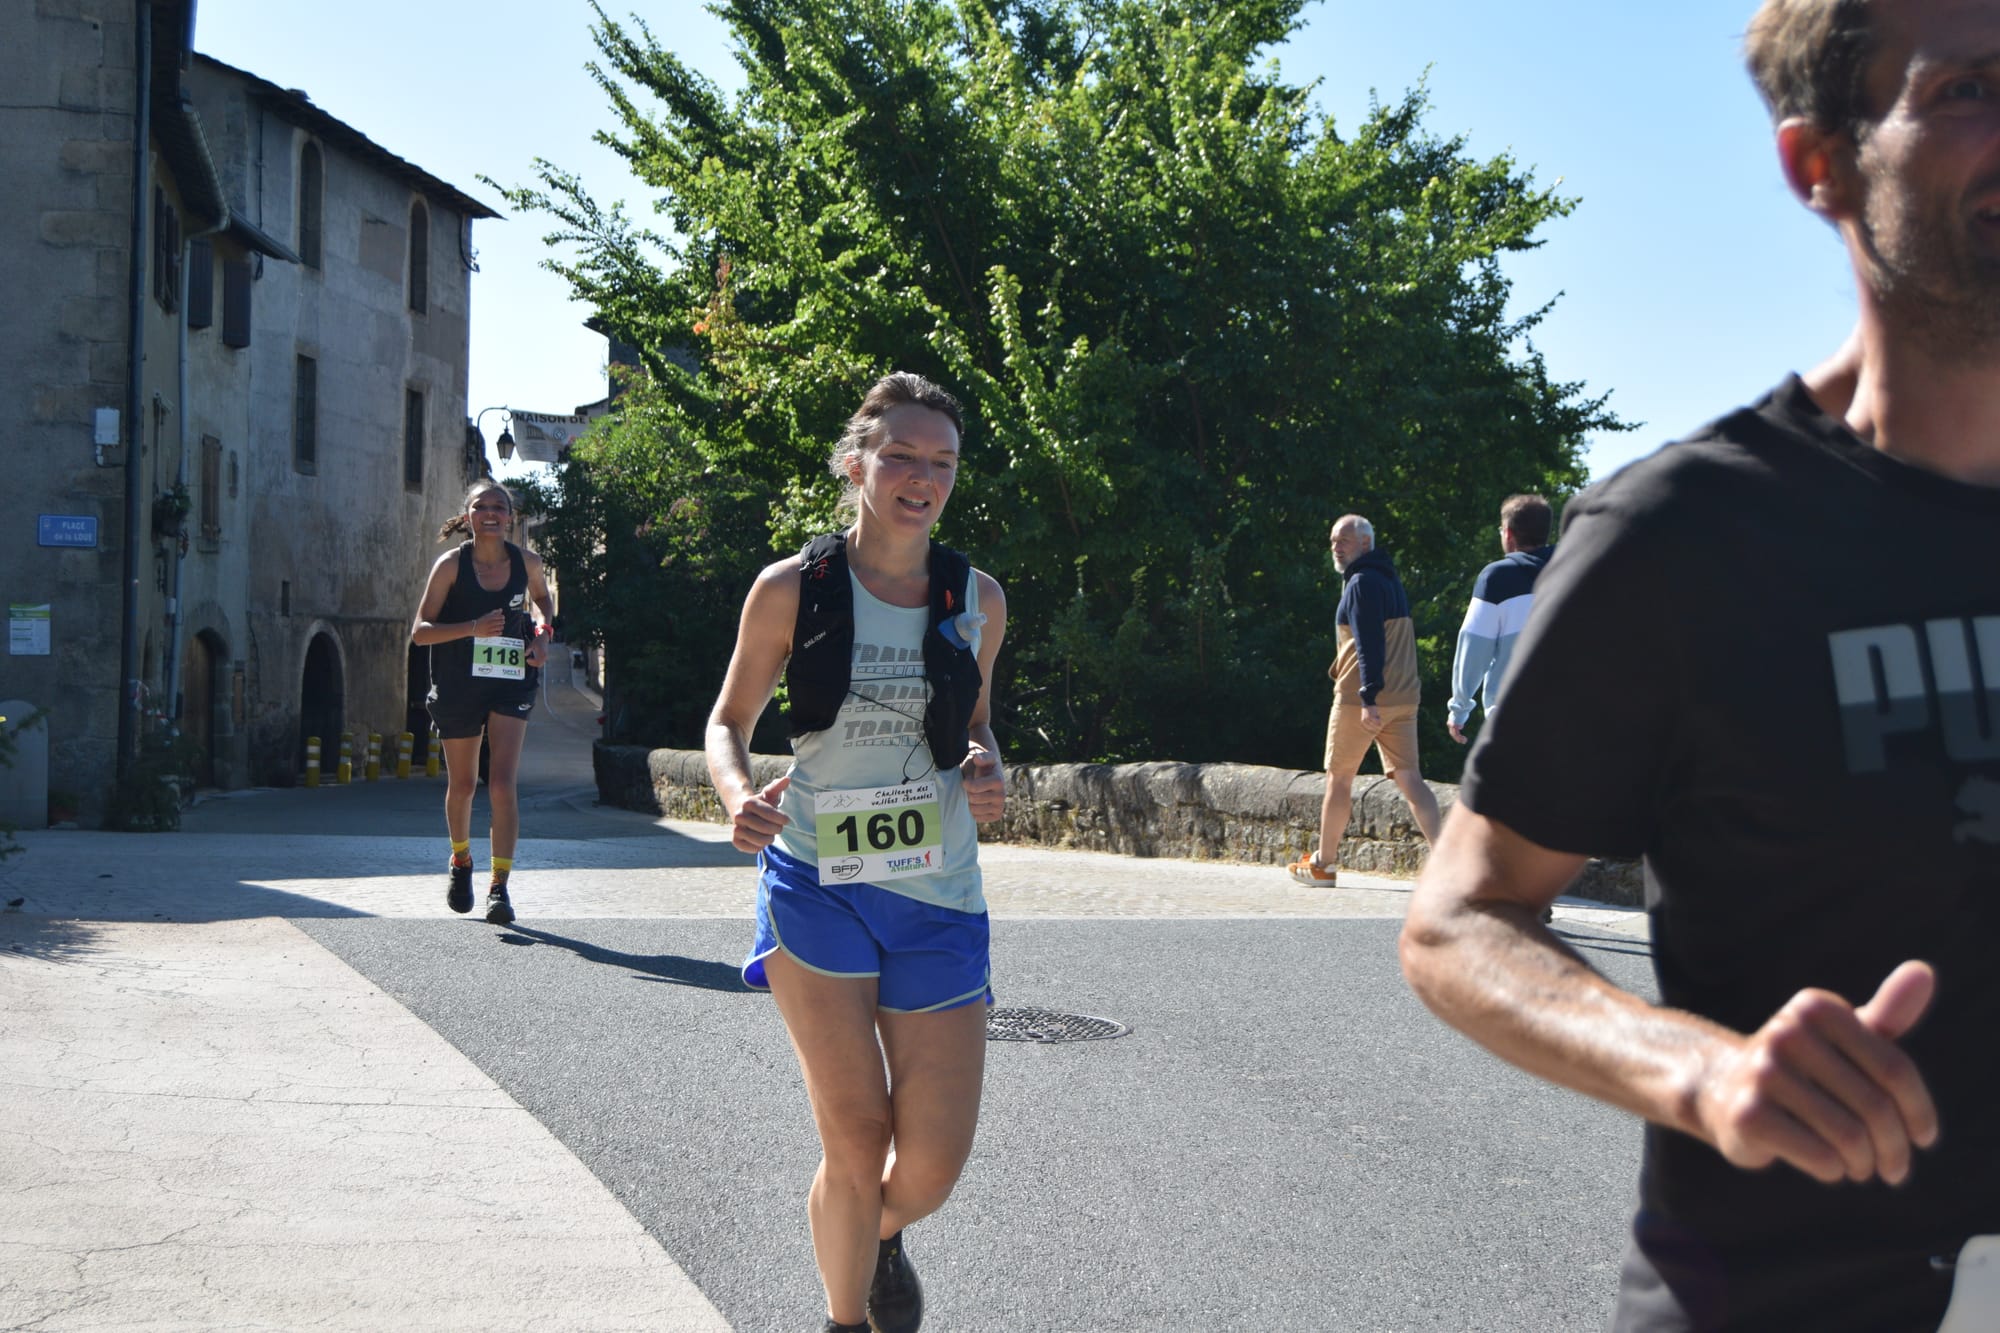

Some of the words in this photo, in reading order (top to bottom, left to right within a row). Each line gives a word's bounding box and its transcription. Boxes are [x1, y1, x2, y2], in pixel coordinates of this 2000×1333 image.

[515, 413, 566, 424] MAISON
[570, 416, 586, 424] DE
[62, 521, 86, 530] PLACE
[482, 647, 519, 666] 118
[875, 788, 912, 798] Challenge
[917, 785, 929, 793] des
[836, 809, 925, 852] 160
[886, 856, 922, 868] TUFF'S
[831, 864, 859, 874] BFP
